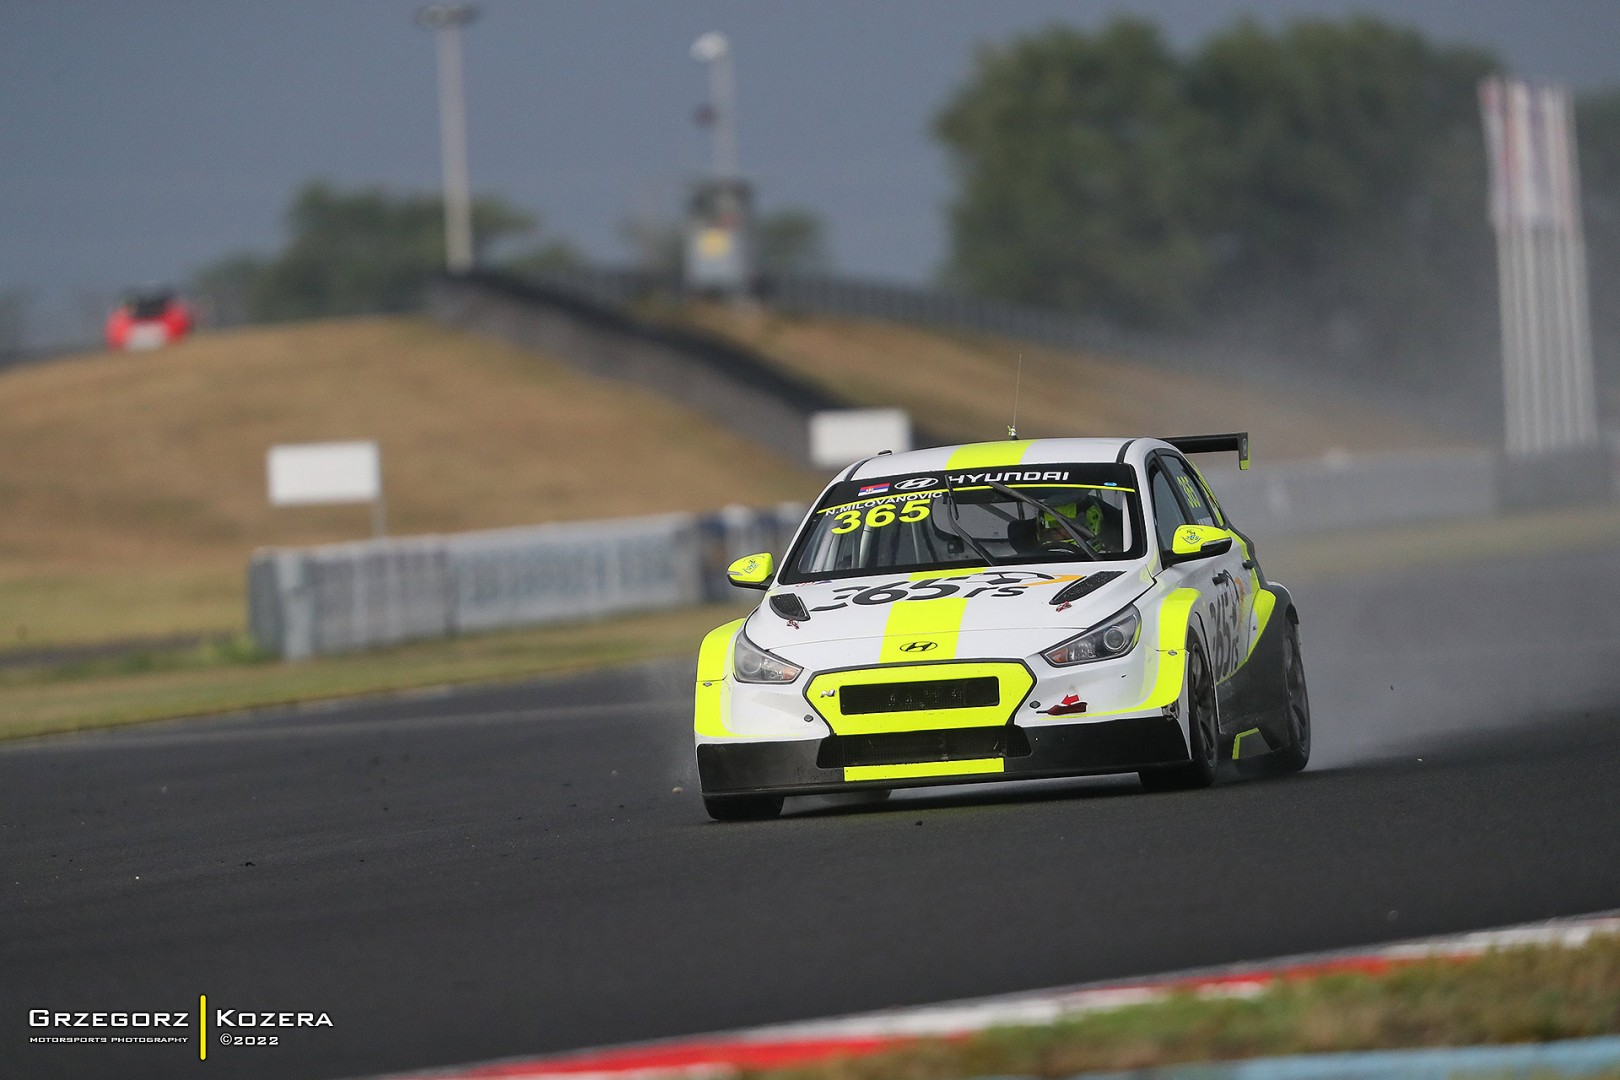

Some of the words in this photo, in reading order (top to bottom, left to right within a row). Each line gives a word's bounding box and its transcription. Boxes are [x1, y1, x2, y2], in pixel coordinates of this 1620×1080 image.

[948, 471, 1070, 484] HYUNDAI
[825, 492, 943, 516] N.MILOVANOVIC
[831, 498, 931, 534] 365
